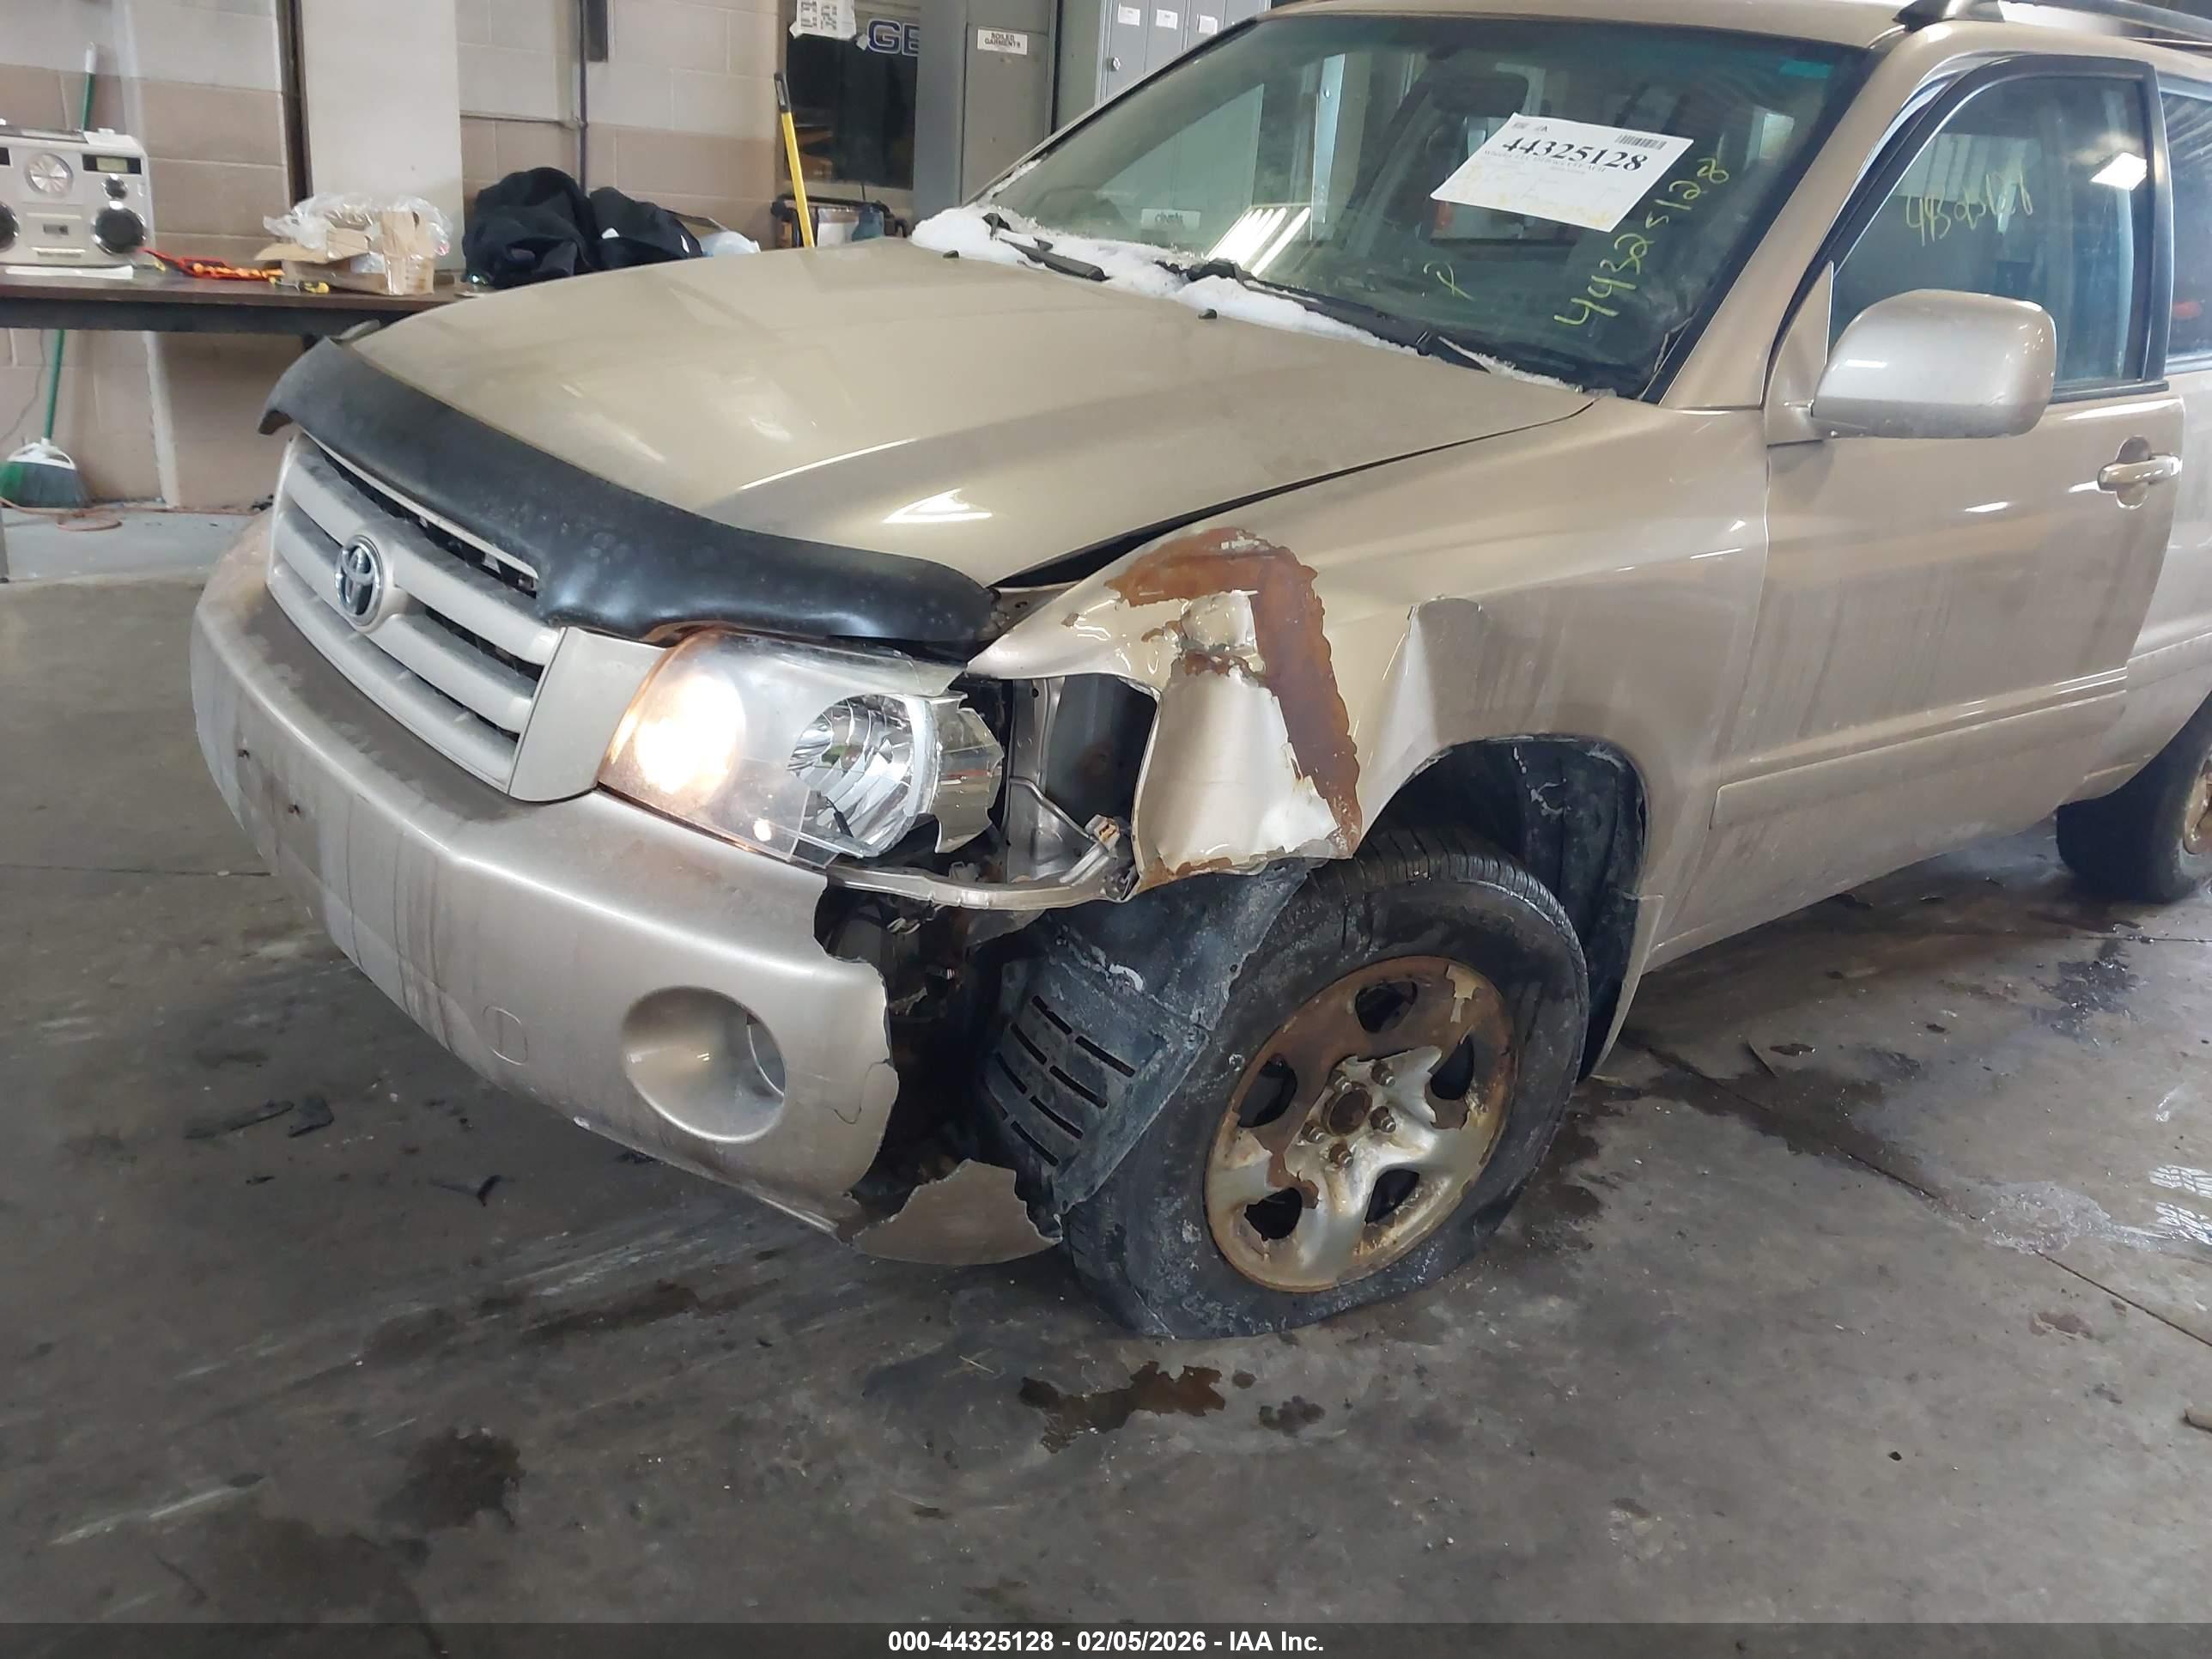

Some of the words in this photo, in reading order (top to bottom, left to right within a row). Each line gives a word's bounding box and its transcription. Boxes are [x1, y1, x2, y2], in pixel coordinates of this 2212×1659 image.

[984, 38, 1021, 48] GARMENTS
[1502, 137, 1649, 172] 44325128
[1553, 156, 1730, 326] 44325128
